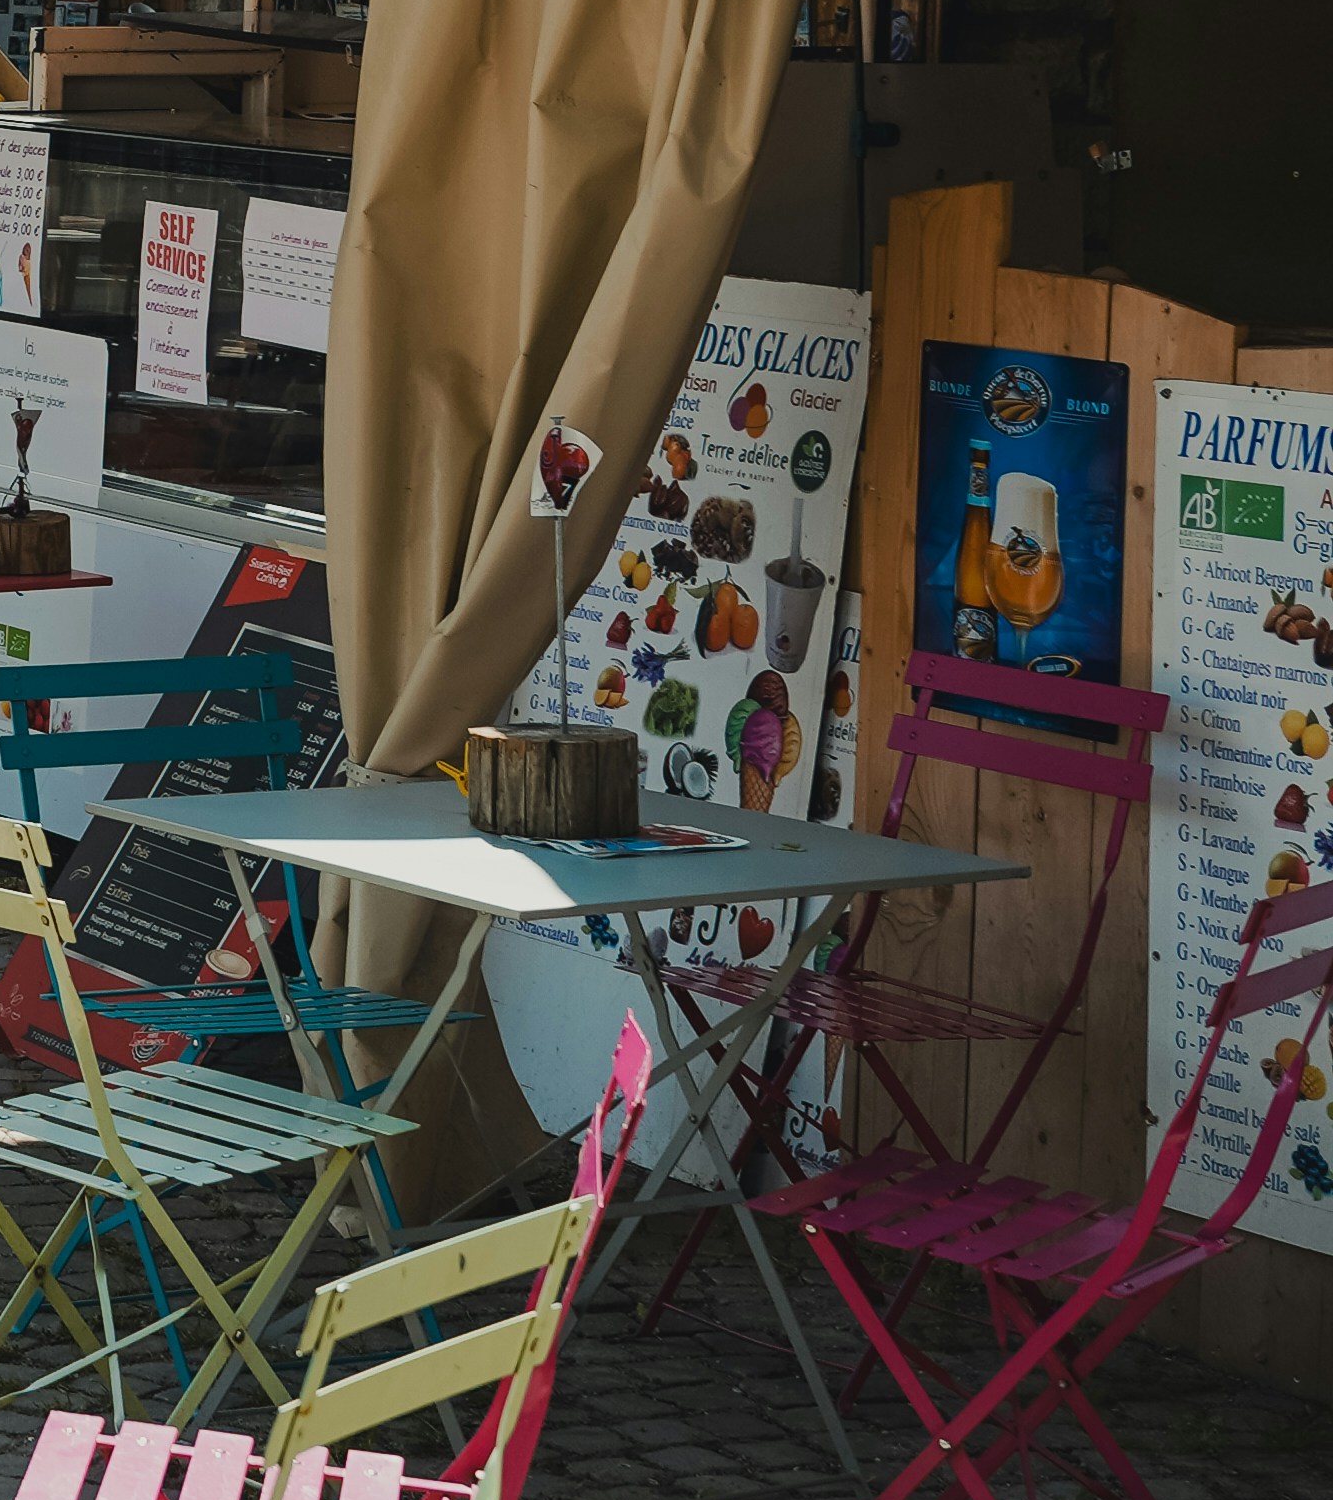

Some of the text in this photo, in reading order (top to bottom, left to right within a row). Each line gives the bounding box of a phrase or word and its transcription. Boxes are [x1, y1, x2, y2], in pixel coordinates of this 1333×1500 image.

[8, 141, 21, 153] des
[22, 142, 47, 158] glaces
[16, 168, 35, 182] 3,00
[37, 170, 44, 181] €
[15, 185, 33, 200] 5,00
[36, 188, 42, 200] €
[14, 204, 32, 218] 7,00
[35, 207, 41, 218] €
[12, 222, 31, 236] 9,00
[34, 225, 40, 236] €
[159, 211, 195, 246] SELF
[146, 240, 206, 284] SERVICE
[146, 279, 201, 300] Commande et
[146, 301, 199, 320] encaissement
[167, 321, 173, 334] à
[150, 337, 190, 358] l'intérieur
[695, 323, 861, 383] DES GLACES
[141, 362, 151, 373] pas
[684, 373, 717, 393] tisan
[929, 380, 972, 397] BLONDE
[790, 388, 841, 412] Glacier
[1066, 398, 1110, 415] BLOND
[701, 433, 789, 470] Terre adélice
[1178, 411, 1333, 475] PARFUM
[705, 464, 733, 476] Glacier
[737, 469, 746, 479] de
[561, 482, 572, 497] 7
[1182, 492, 1217, 529] AB
[1183, 557, 1314, 593] S Abricot Bergeron
[612, 586, 638, 605] Corse
[1182, 587, 1259, 615] G Amande
[1182, 616, 1235, 641] G Café
[1181, 646, 1327, 687] S Chataignes marrons
[533, 669, 584, 696] S Mague
[1180, 675, 1287, 710] S Chocolat noir
[530, 694, 614, 726] G Methe feuilles
[1180, 705, 1241, 733] S Citron
[177, 760, 191, 772] Café
[1179, 735, 1314, 776] S Clémentine Corse
[171, 771, 185, 783] Café
[1179, 764, 1266, 797] S Framboise
[1179, 794, 1238, 822] S Fraise
[130, 843, 151, 860] Thés
[1178, 824, 1256, 856] G Lavande
[120, 862, 133, 875] Thés
[1178, 853, 1250, 887] S Mangue
[105, 882, 133, 902] Extras
[1177, 882, 1249, 914] G Menthe
[1177, 912, 1186, 931] S
[1197, 916, 1229, 942] Noix
[1176, 942, 1241, 974] G Nouga
[1176, 971, 1186, 991] S
[1176, 1001, 1185, 1020] S
[1175, 1031, 1187, 1050] G
[1175, 1060, 1241, 1095] G anille
[1198, 1096, 1249, 1126] Caramel
[1295, 1121, 1321, 1146] salé
[1202, 1131, 1252, 1157] Myrtille
